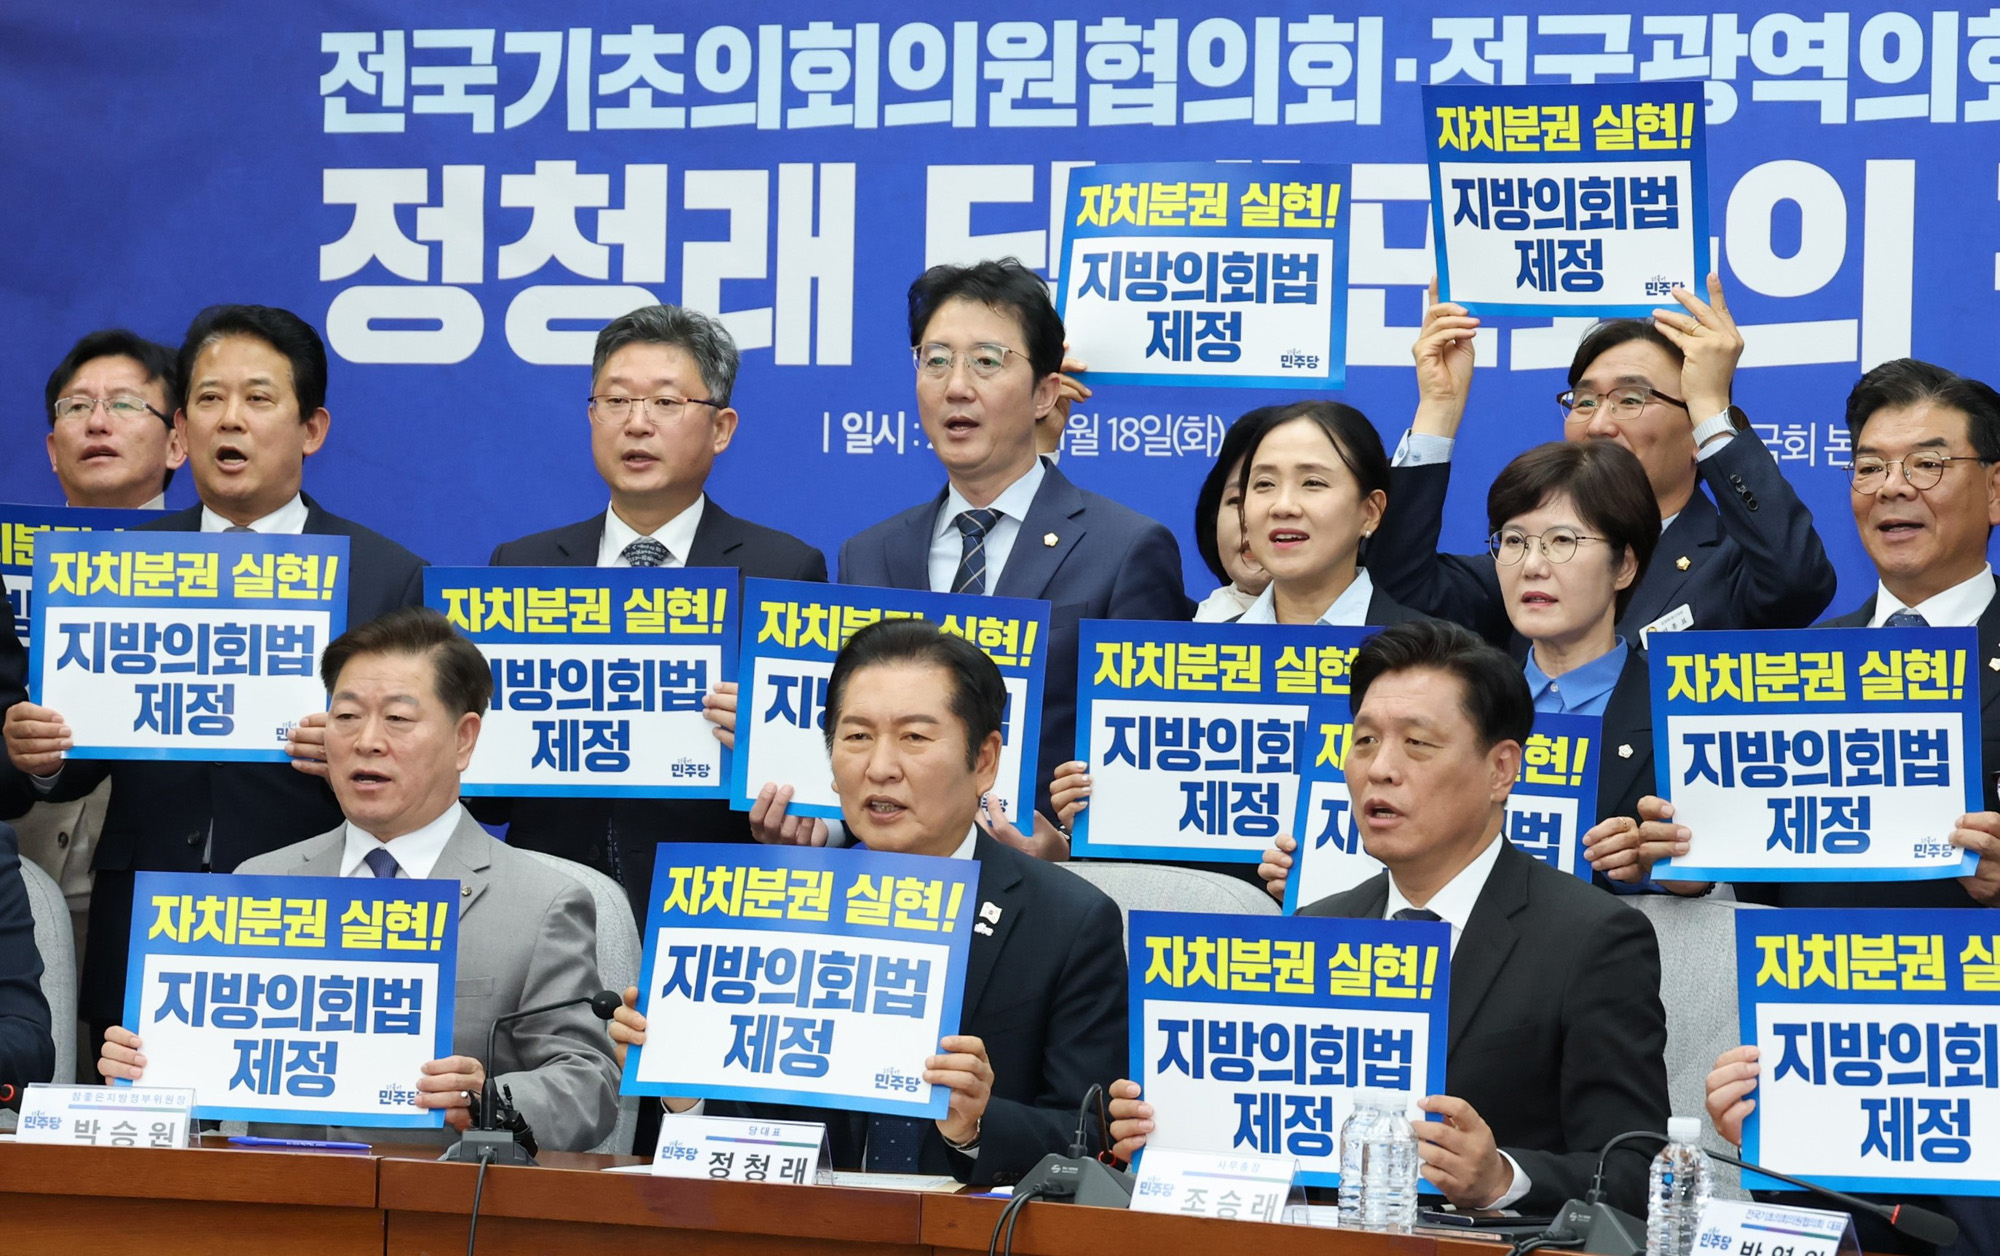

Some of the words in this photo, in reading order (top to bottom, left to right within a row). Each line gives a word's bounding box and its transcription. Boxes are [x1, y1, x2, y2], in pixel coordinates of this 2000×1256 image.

[1437, 105, 1581, 152] 자치분권
[1593, 102, 1695, 151] 실현!
[1077, 183, 1228, 226] 자치분권
[1241, 182, 1341, 228] 실현!
[1451, 176, 1679, 231] 지방의회법
[319, 160, 856, 366] 정청래
[1078, 251, 1319, 305] 지방의회법
[1514, 238, 1604, 293] 제정
[1146, 310, 1242, 363] 제정
[1281, 355, 1320, 369] 민주당
[1107, 413, 1224, 458] 18일(화)
[1823, 423, 1854, 466] 본
[49, 551, 218, 597] 자치분권
[233, 554, 338, 600] 실현!
[442, 587, 611, 633] 자치분권
[624, 587, 727, 634] 실현!
[57, 622, 314, 677] 지방의회법
[1095, 642, 1262, 692] 자치분권
[1275, 646, 1360, 695] 실현
[1667, 651, 1846, 703] 자치분권
[1859, 649, 1967, 700] 실현!
[134, 682, 234, 736] 제정
[531, 719, 630, 773] 제정
[671, 764, 711, 778] 민주당
[1104, 715, 1306, 775] 지방의회
[1516, 734, 1589, 786] 현!
[1683, 728, 1950, 788] 지방의회법
[1179, 780, 1280, 838] 제정
[1766, 795, 1871, 854] 제정
[1914, 844, 1955, 858] 민주당
[149, 895, 327, 947] 자치분권
[341, 900, 448, 950] 실현!
[664, 866, 834, 921] 자치분권
[846, 875, 964, 931] 실현!
[662, 944, 932, 1019] 지방의회법
[1145, 936, 1315, 994] 자치분권
[1329, 943, 1439, 999] 실현!
[1756, 934, 1947, 991] 자치분권
[154, 971, 423, 1036] 지방의회법
[229, 1039, 338, 1098] 제정
[724, 1014, 834, 1078] 제정
[1157, 1019, 1413, 1091] 지방의회법
[875, 1073, 921, 1093] 민주당
[24, 1115, 62, 1131] 민주당
[74, 1119, 176, 1148] 박승원
[748, 1125, 782, 1137] 당대표
[1233, 1092, 1334, 1157] 제정
[1860, 1097, 1972, 1164] 제정
[661, 1145, 698, 1162] 민주당
[708, 1151, 808, 1184] 정청래
[1139, 1181, 1175, 1198] 민주당
[1180, 1188, 1280, 1222] 조승래
[1699, 1232, 1733, 1251] 민주당
